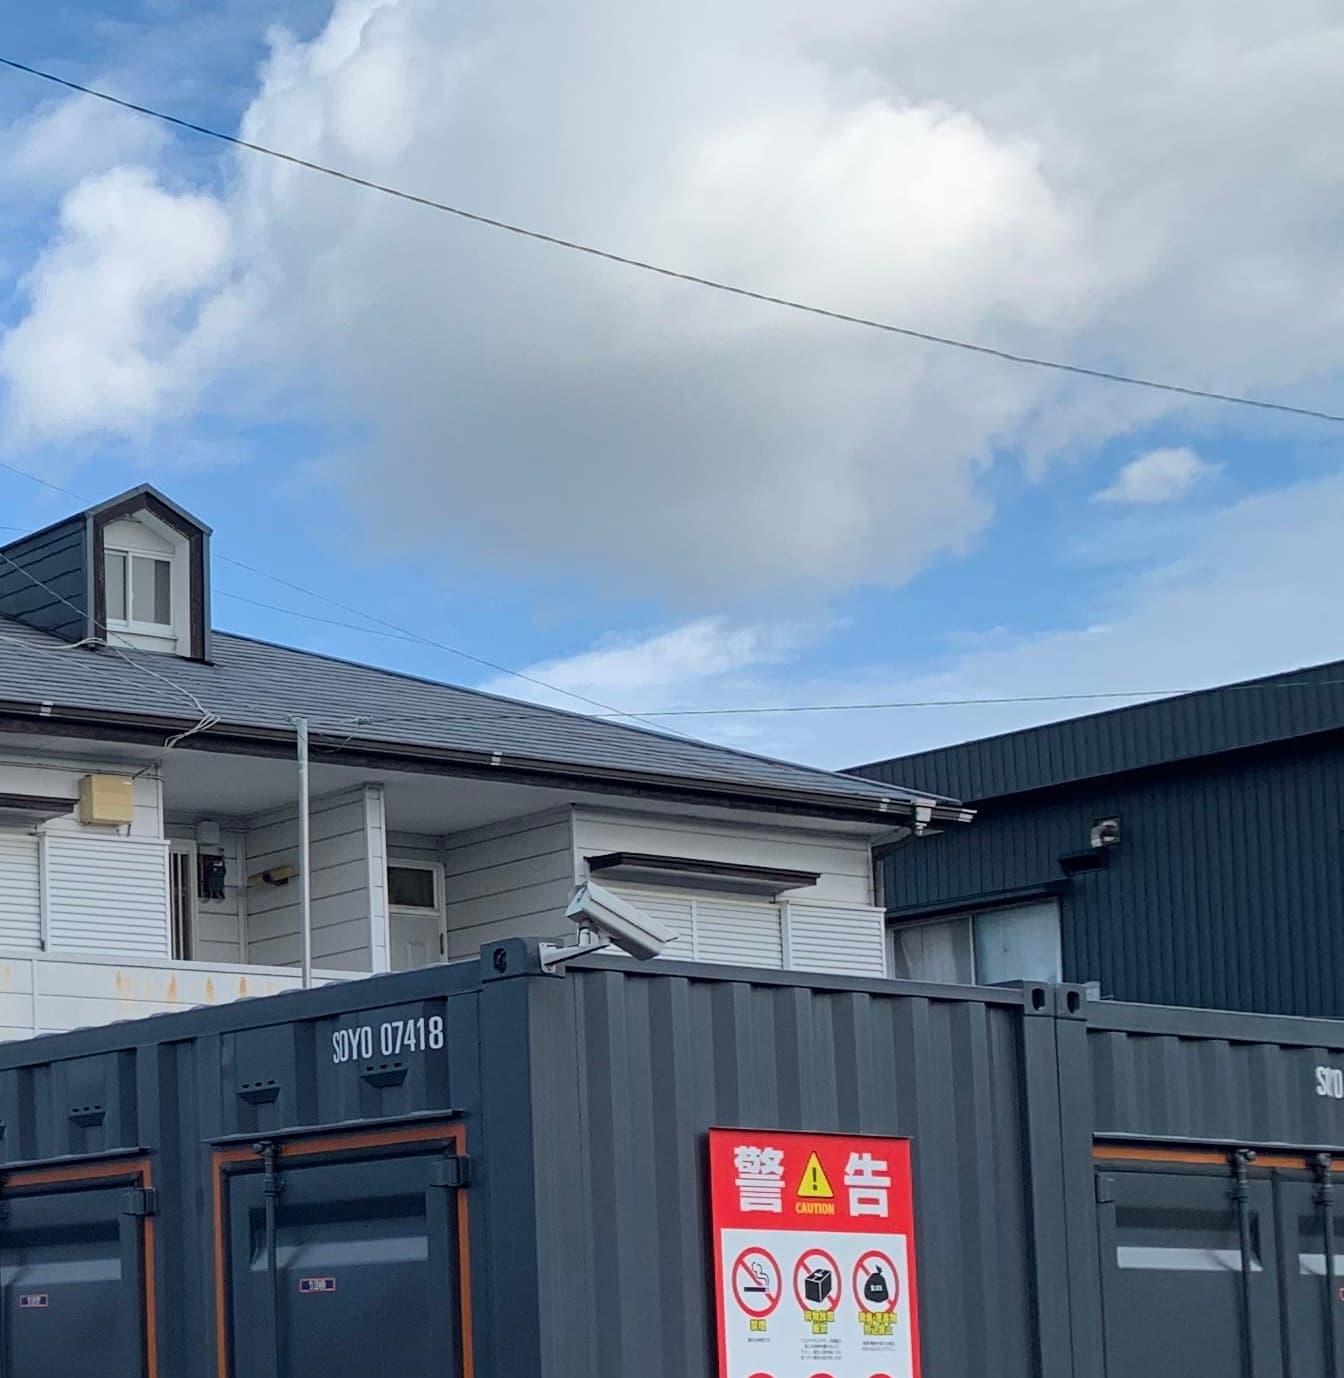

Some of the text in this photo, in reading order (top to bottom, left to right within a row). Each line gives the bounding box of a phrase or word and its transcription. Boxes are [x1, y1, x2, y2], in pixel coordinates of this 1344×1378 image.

[380, 1015, 444, 1056] 07418
[733, 1145, 892, 1218] 警 告
[795, 1201, 835, 1215] CAUTION
